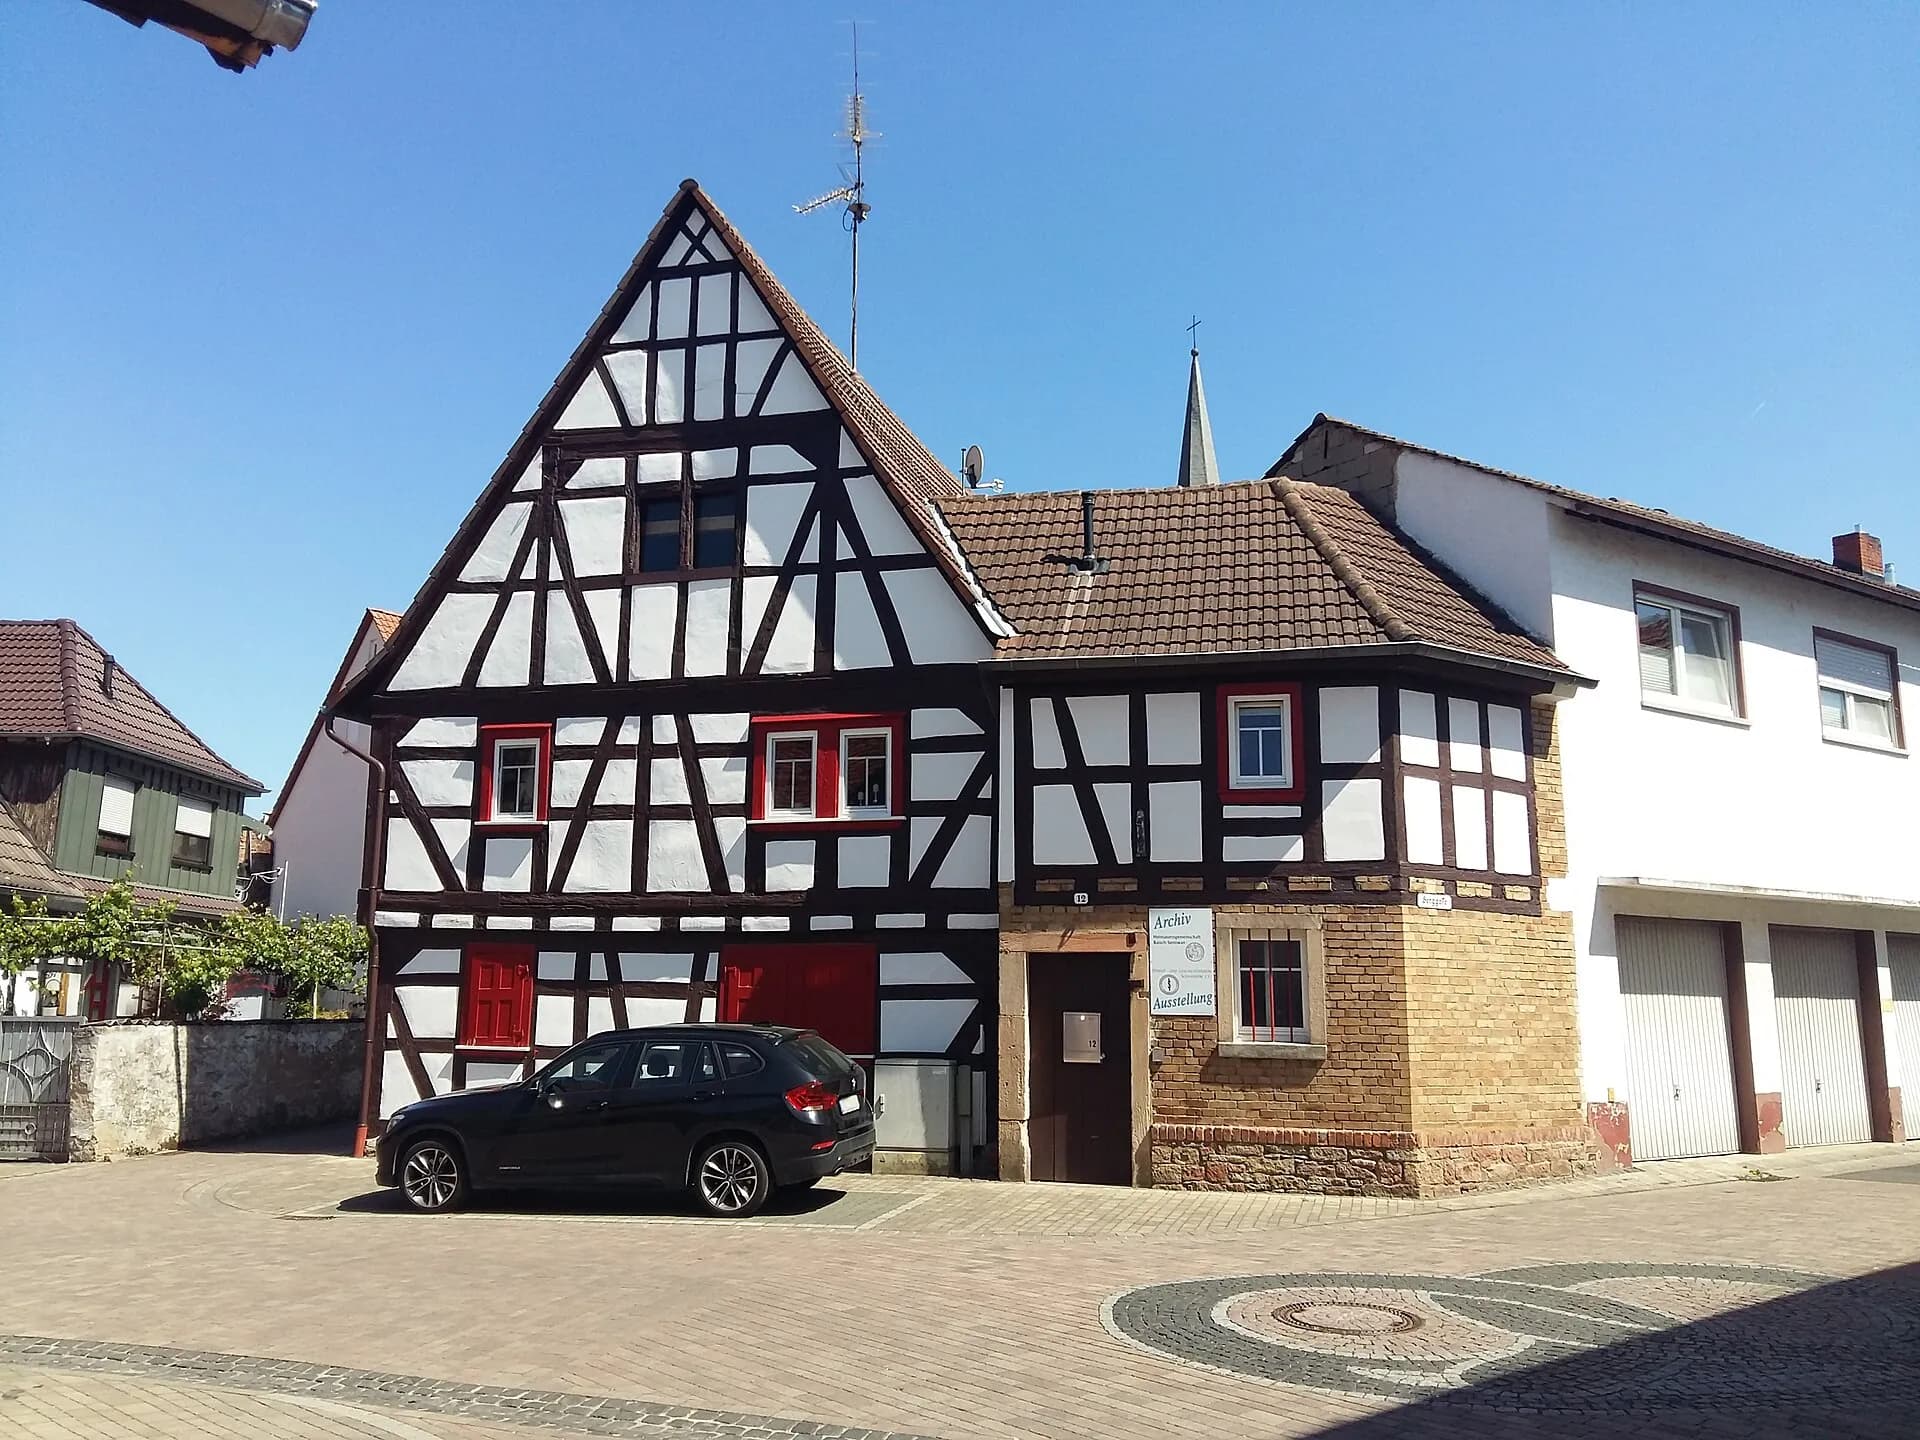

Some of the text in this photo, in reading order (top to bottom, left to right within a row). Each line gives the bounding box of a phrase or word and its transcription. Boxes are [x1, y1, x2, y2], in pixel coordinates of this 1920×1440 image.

[1077, 894, 1087, 903] 12
[1153, 912, 1191, 930] Archiv
[1153, 992, 1212, 1010] Ausstellung
[1088, 1039, 1097, 1048] 12
